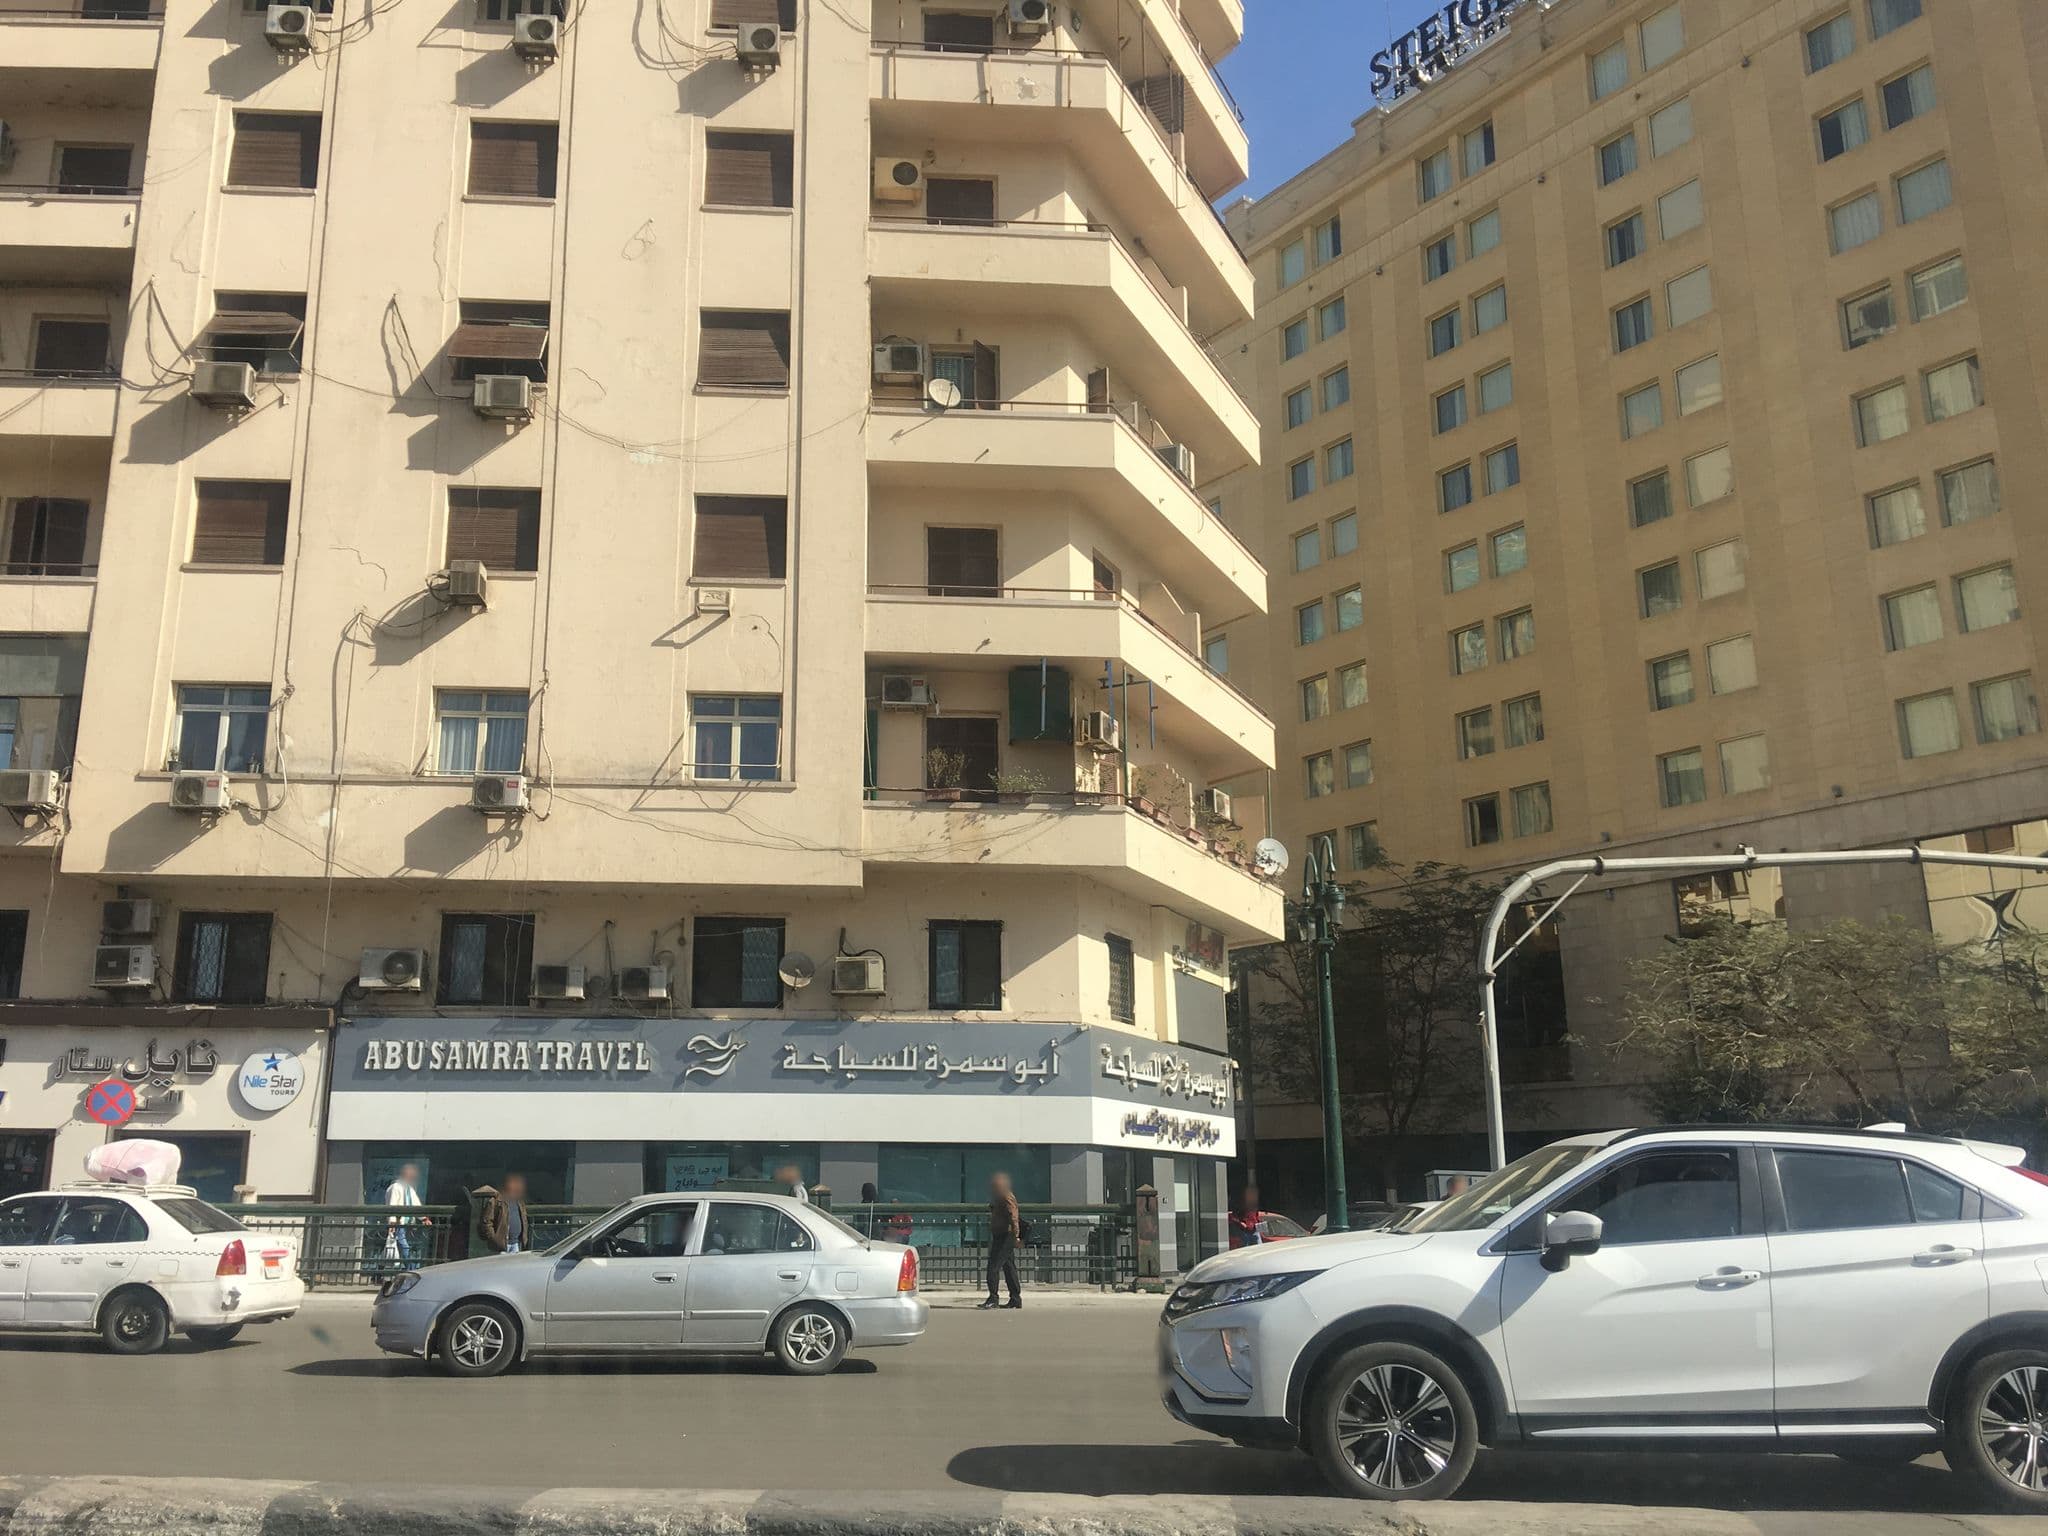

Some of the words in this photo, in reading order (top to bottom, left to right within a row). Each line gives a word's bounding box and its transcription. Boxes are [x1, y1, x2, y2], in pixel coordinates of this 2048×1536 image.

[1369, 0, 1516, 95] STEIG
[54, 1046, 113, 1080] ستار
[121, 1040, 218, 1087] نايل
[364, 1039, 426, 1071] ABU
[428, 1040, 532, 1071] SAMRA
[536, 1041, 652, 1072] TRAVEL
[782, 1041, 919, 1080] للسياحة
[924, 1042, 1009, 1080] سمرة
[1013, 1039, 1061, 1084] أبو
[243, 1074, 268, 1088] Nile
[270, 1074, 297, 1088] Star
